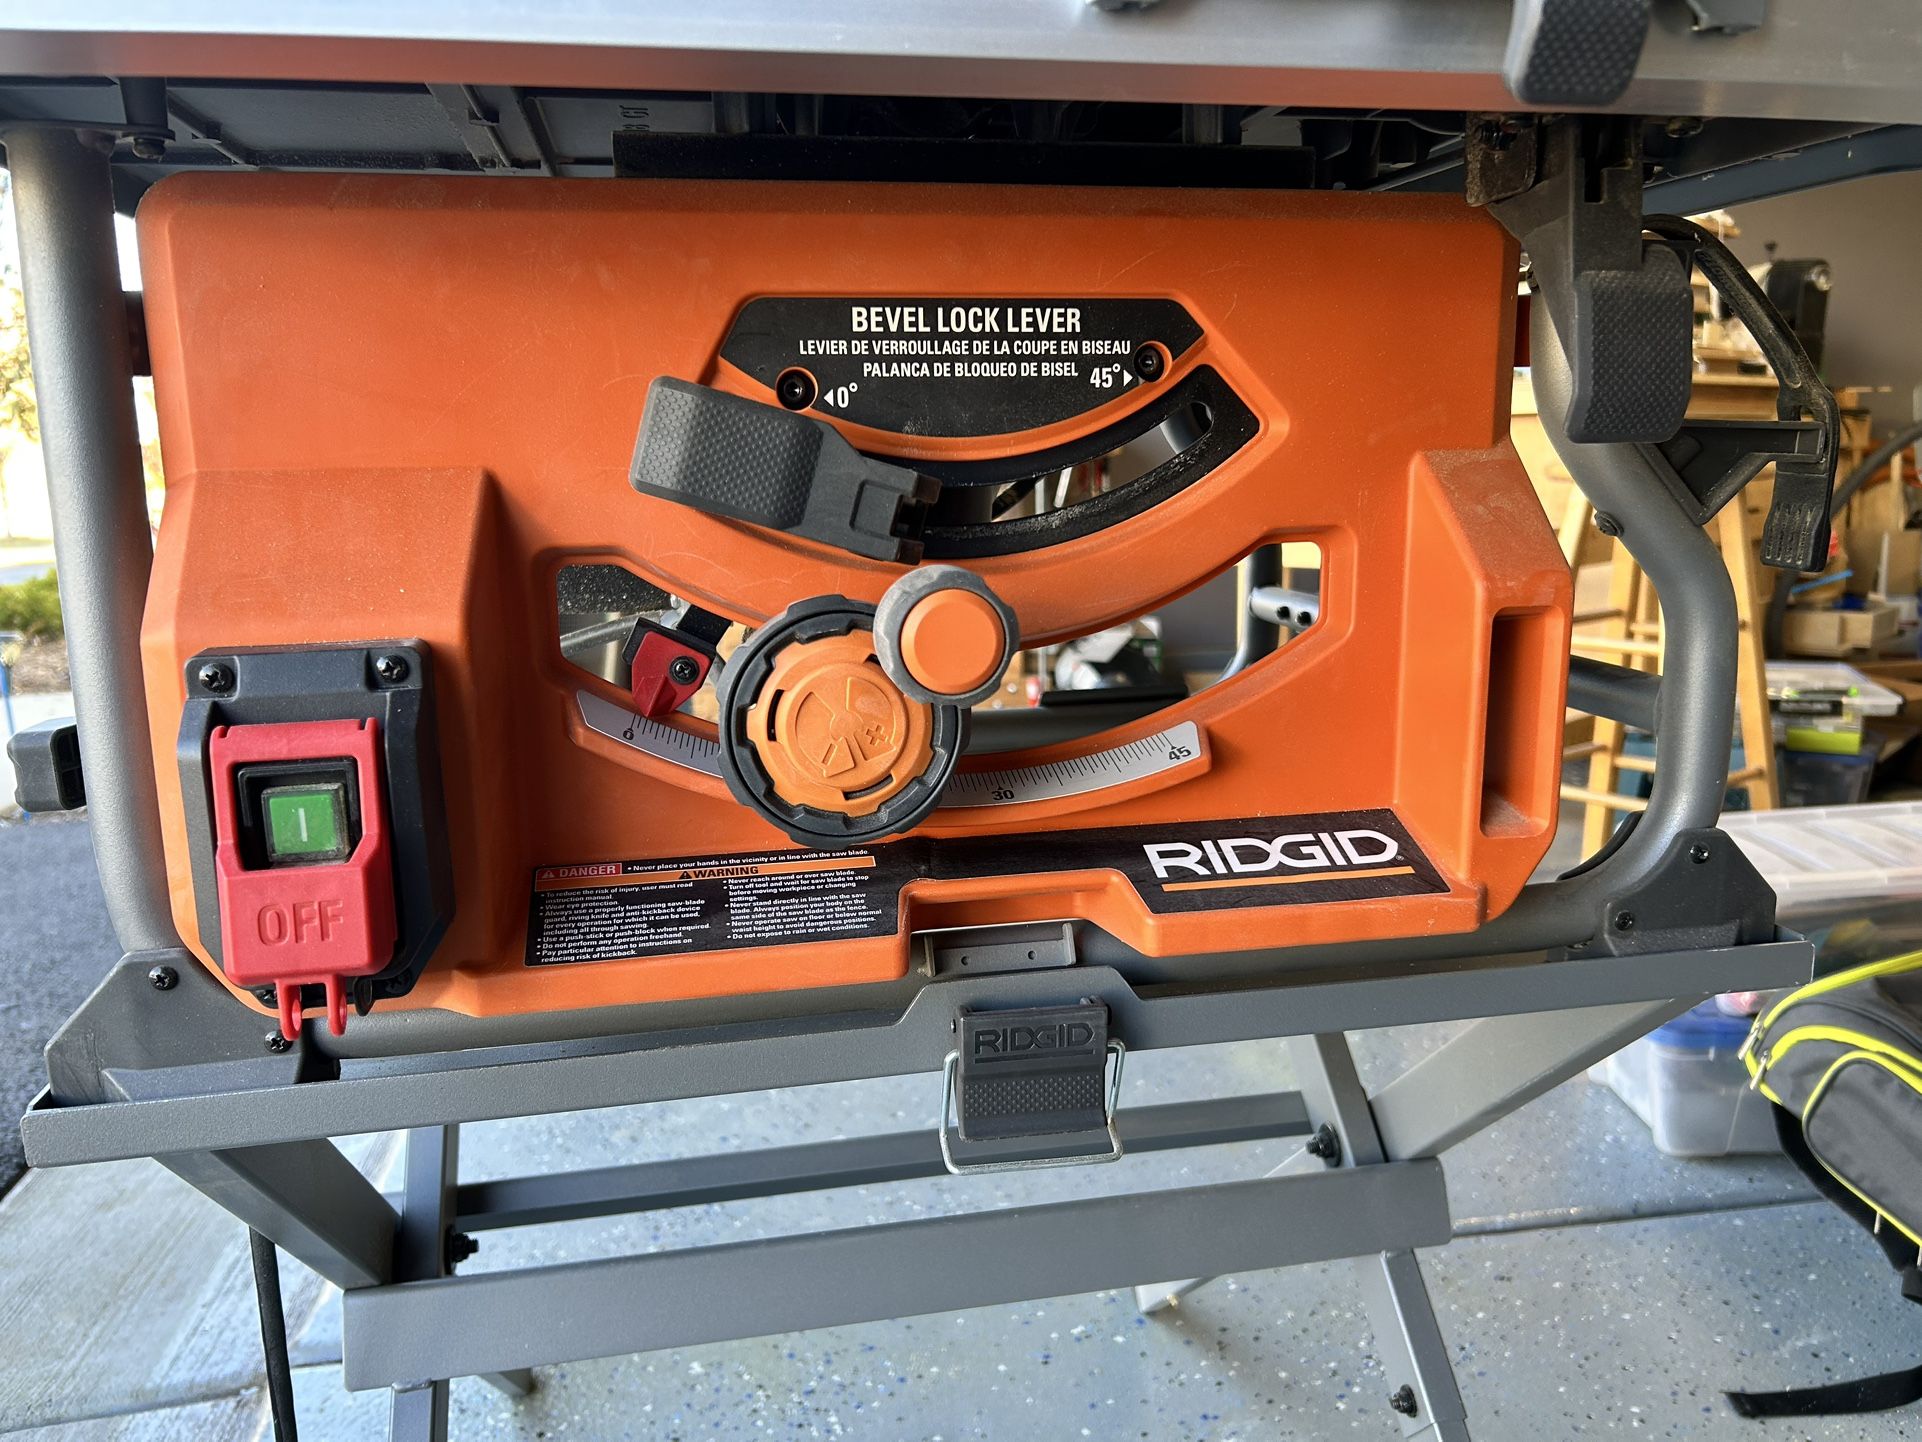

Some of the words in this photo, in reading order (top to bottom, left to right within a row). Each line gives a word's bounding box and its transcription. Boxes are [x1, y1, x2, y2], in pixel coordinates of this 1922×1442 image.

[852, 306, 930, 333] BEVEL
[937, 306, 1000, 333] LOCK
[1007, 307, 1081, 333] LEVER
[799, 340, 848, 355] LEVIER
[851, 340, 869, 355] DE
[872, 340, 969, 355] VERROULLAGE
[972, 340, 990, 355] DE
[993, 340, 1010, 355] LA
[1013, 340, 1057, 355] COUPE
[1061, 340, 1078, 355] EN
[1082, 340, 1131, 355] BISEAU
[863, 362, 930, 377] PALANCA
[933, 362, 951, 377] DE
[954, 362, 1017, 377] BLOQUEO
[1020, 362, 1038, 377] DE
[1041, 362, 1079, 377] BISEL
[1090, 363, 1121, 388] 45°
[836, 382, 858, 408] 0°
[1168, 746, 1191, 762] 45
[992, 789, 1015, 801] 30
[1143, 829, 1399, 879] RIDGID
[559, 865, 616, 878] DANGER
[693, 866, 759, 879] WARNING
[257, 900, 344, 947] OFF
[974, 1021, 1095, 1055] RIDGID
